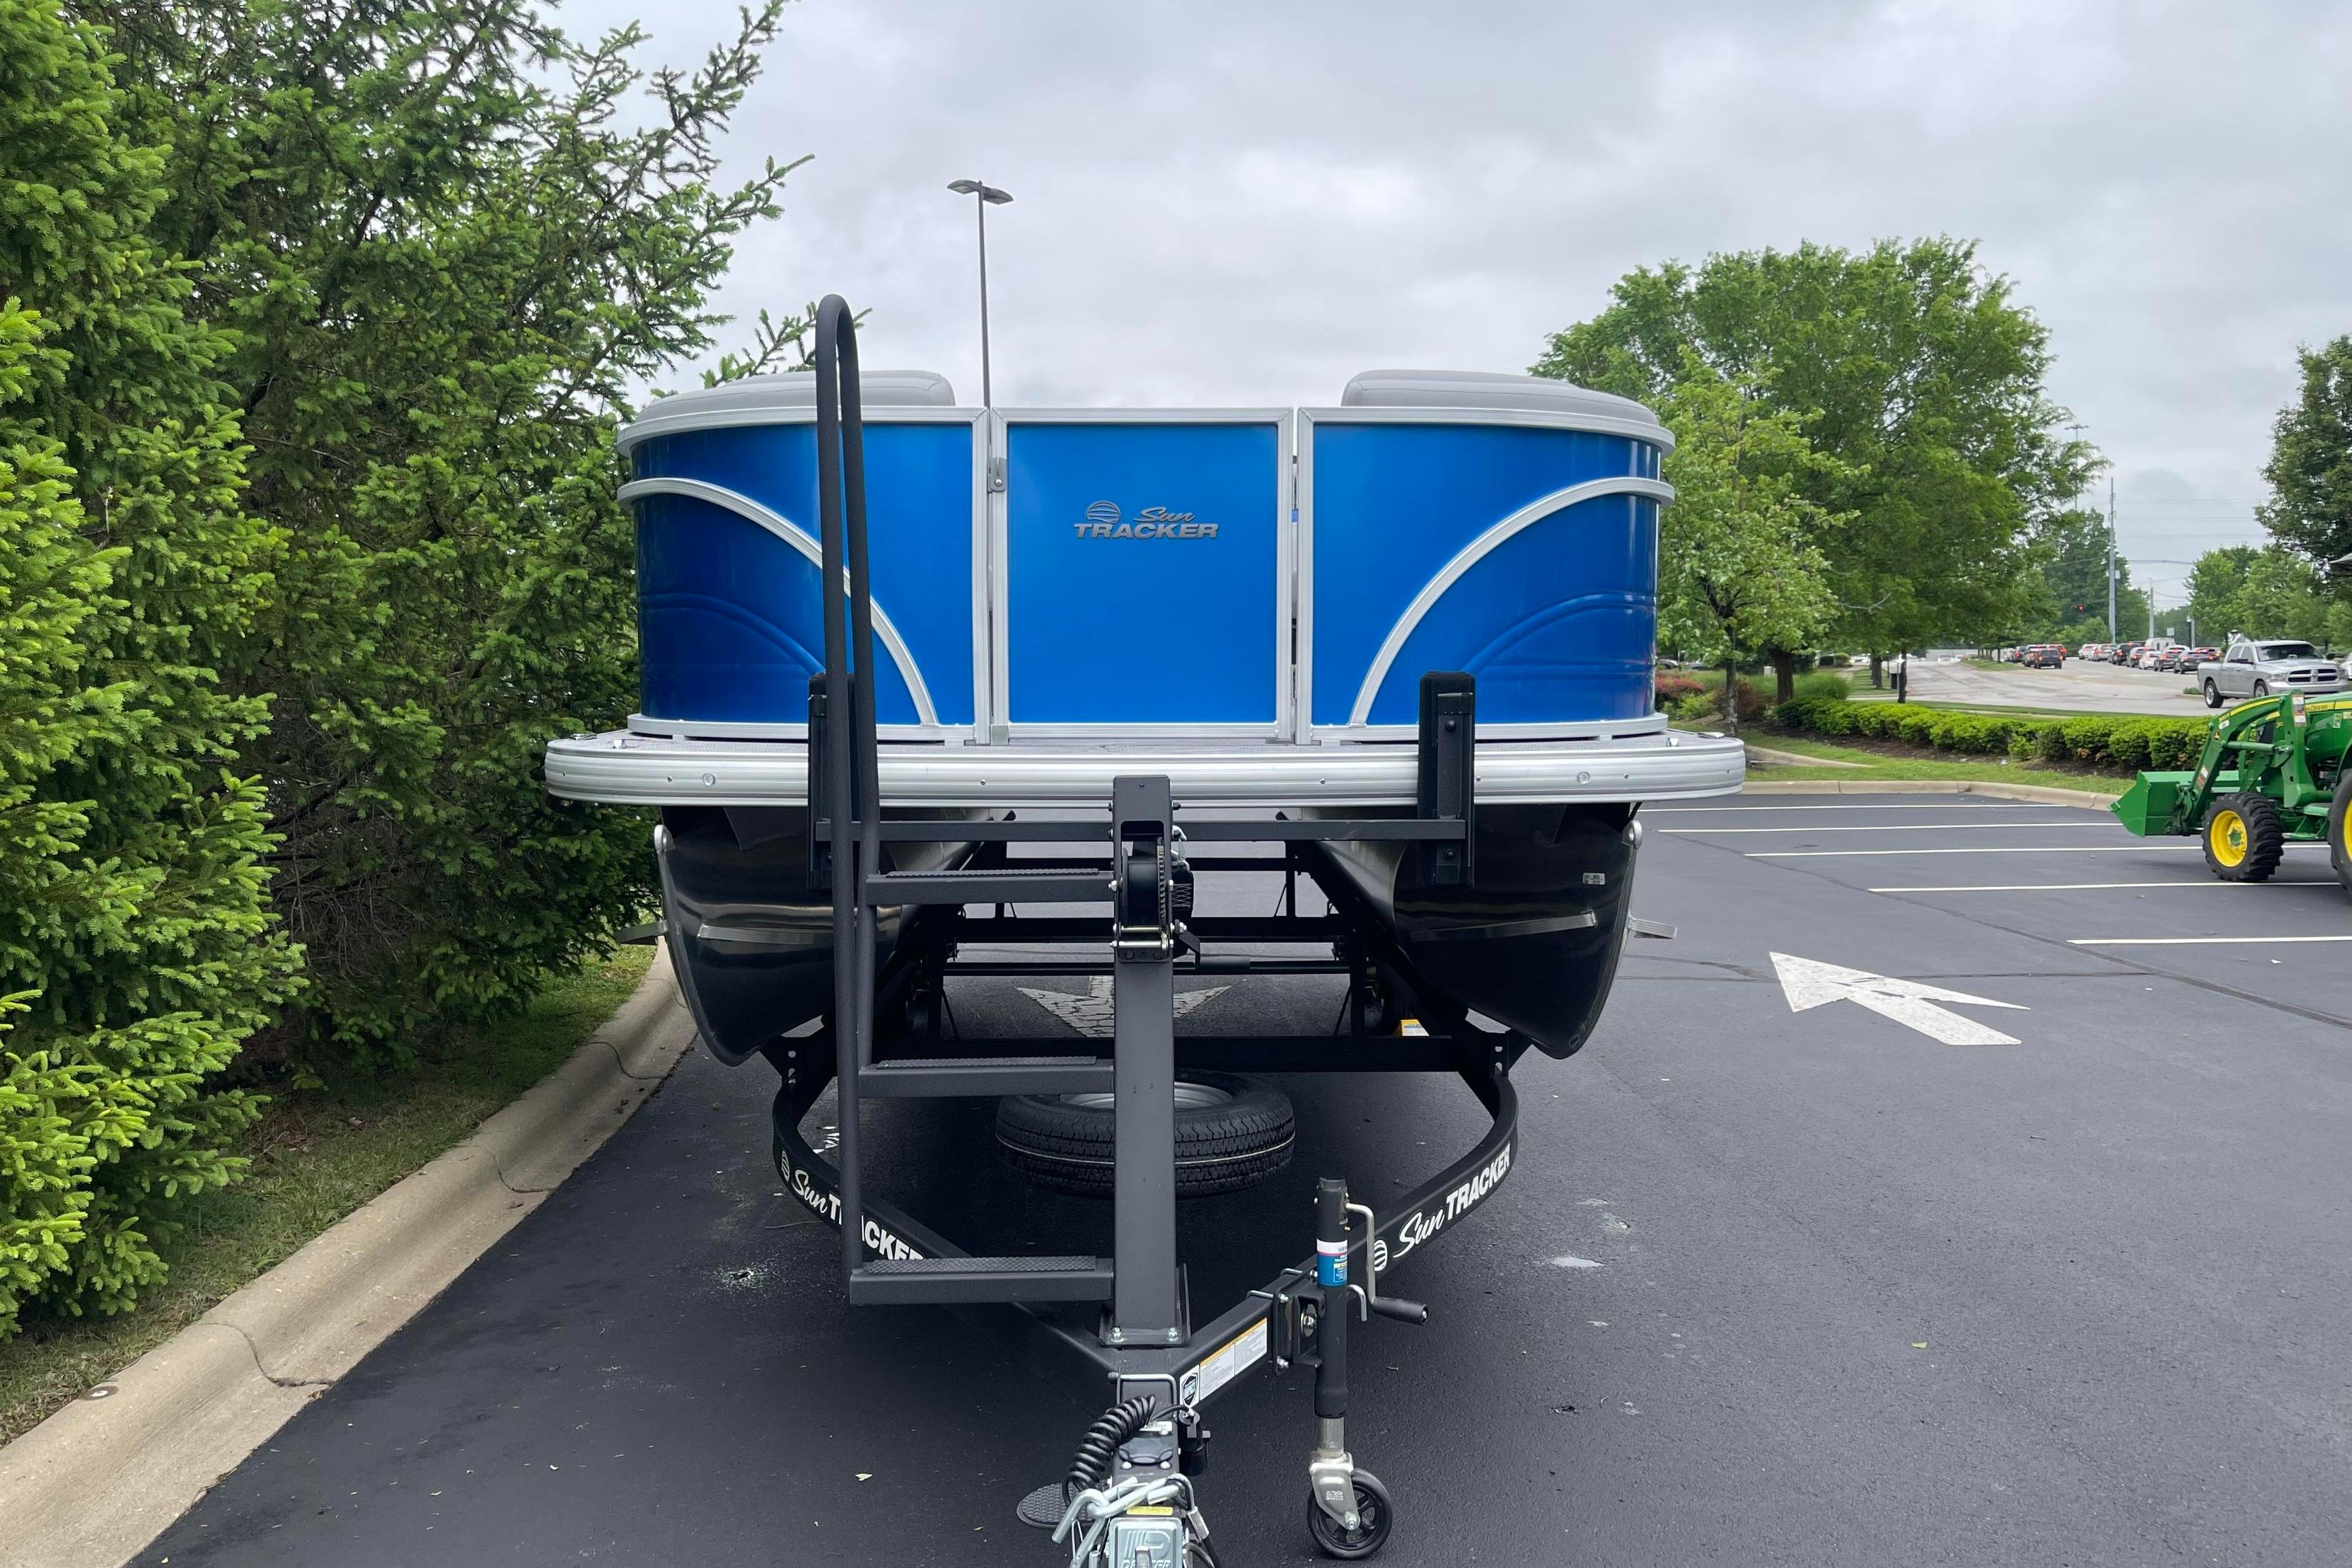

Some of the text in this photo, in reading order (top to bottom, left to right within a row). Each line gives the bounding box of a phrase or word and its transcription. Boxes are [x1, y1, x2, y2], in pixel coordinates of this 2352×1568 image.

[1073, 523, 1219, 539] TRACKER
[1133, 506, 1195, 523] Sun
[792, 1169, 924, 1260] Sun TCKE
[1393, 1142, 1511, 1258] Sun TRACKER
